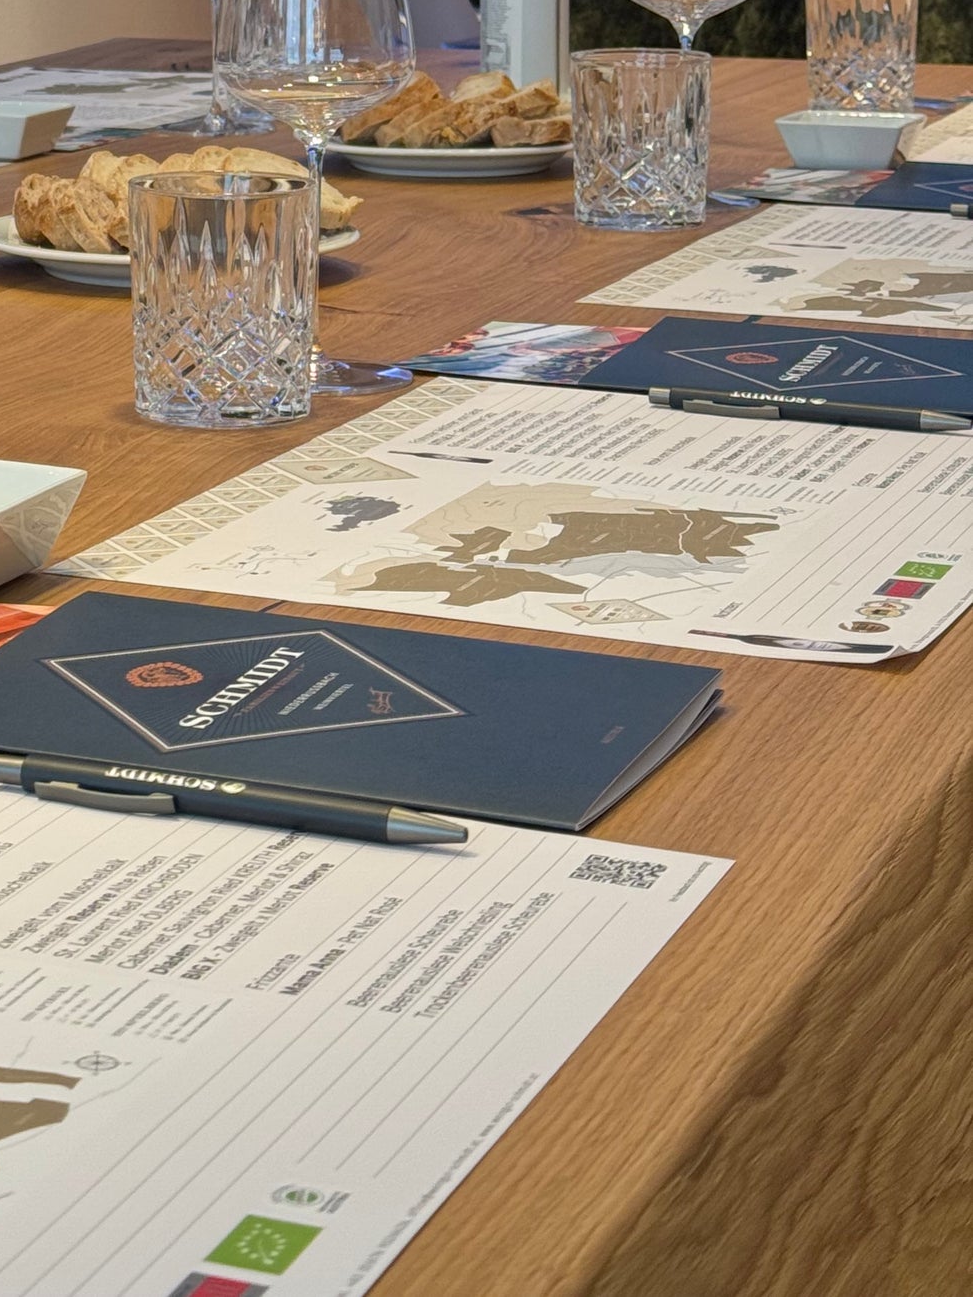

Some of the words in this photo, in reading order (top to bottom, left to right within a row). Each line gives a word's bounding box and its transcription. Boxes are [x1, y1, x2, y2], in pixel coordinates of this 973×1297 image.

[178, 647, 306, 730] SCHMIDT
[104, 767, 219, 792] SCHMIDT
[20, 922, 78, 954] Zweigelt
[65, 892, 118, 922] Reserve
[107, 877, 138, 893] Alte
[126, 855, 168, 878] Reben
[38, 901, 70, 917] vom
[58, 859, 128, 901] Muschelkalk
[52, 948, 81, 959] St.
[68, 917, 121, 947] Laurent
[107, 900, 143, 918] Ried
[131, 853, 204, 901] KIRCHBODEN
[84, 937, 132, 964] Merlot
[118, 919, 154, 938] Ried
[139, 889, 194, 920] ÖLBERG
[116, 933, 176, 970] Cabernet
[162, 895, 229, 934] Sauvignon
[210, 877, 244, 896] Ried
[231, 850, 278, 879] KREUTH
[148, 944, 199, 975] Diadem
[193, 904, 256, 941] Cabernet,
[237, 878, 281, 903] Merlot
[275, 851, 314, 873] Shiraz
[180, 964, 213, 981] BIG
[213, 920, 270, 955] Zweigelt
[258, 890, 302, 915] Merlot
[288, 863, 335, 891] Reserve
[353, 915, 384, 930] Nat
[368, 897, 403, 916] Rosé
[245, 953, 301, 991] Frizzante
[309, 948, 346, 970] Anna
[336, 929, 368, 944] Pet
[346, 949, 422, 1008] Beerenauslese
[407, 909, 464, 950] Scheurebe
[379, 954, 455, 1014] Beerenauslese
[440, 901, 515, 957] Welschriesling
[414, 931, 516, 1018] Trockenbeerenauslese
[502, 892, 555, 931] Scheurebe
[279, 970, 323, 996] Mama
